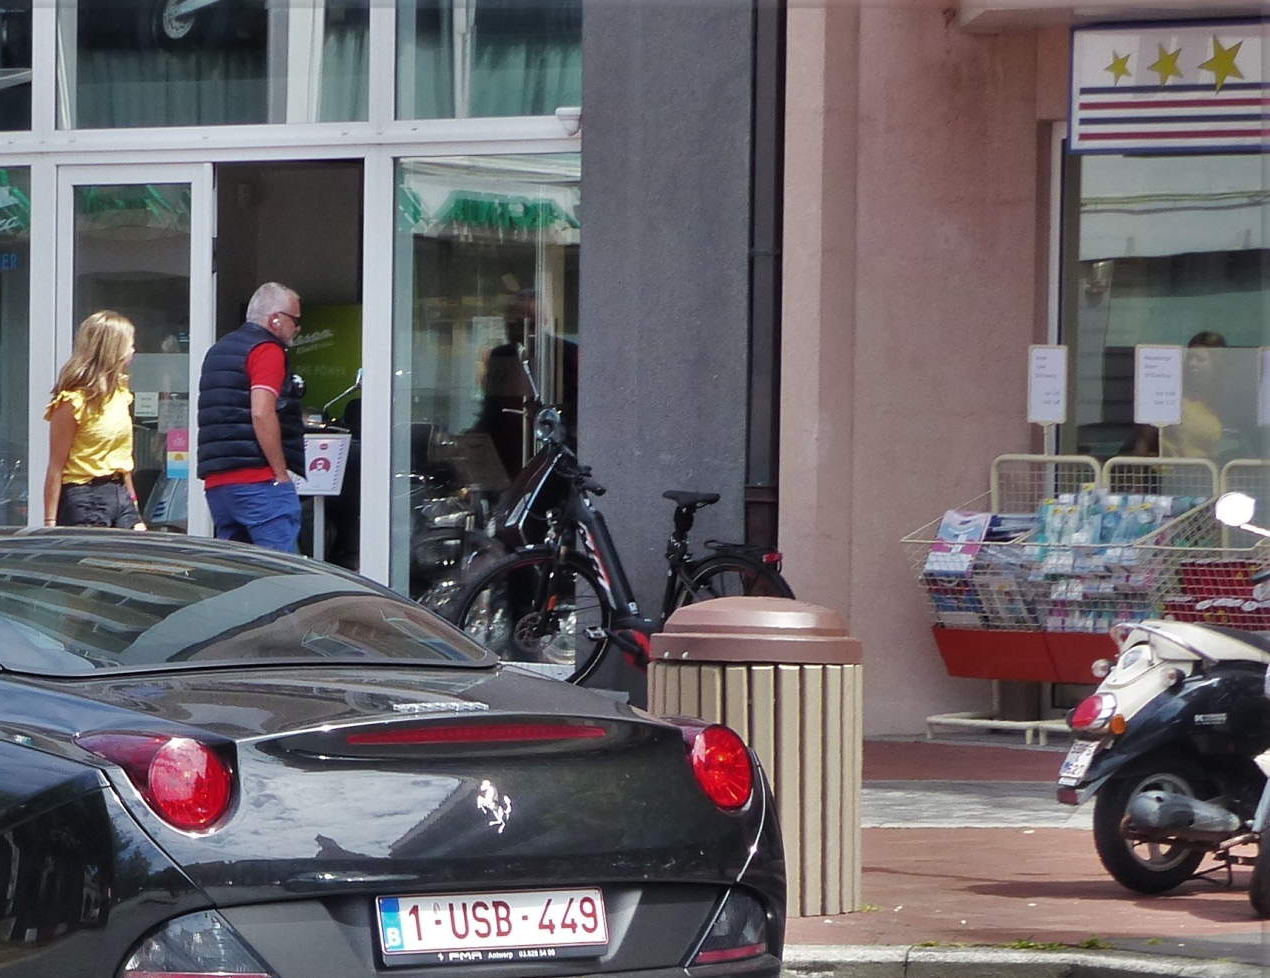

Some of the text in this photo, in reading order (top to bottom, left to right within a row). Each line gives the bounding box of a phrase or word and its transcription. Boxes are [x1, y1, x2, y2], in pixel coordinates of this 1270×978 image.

[387, 896, 599, 947] B 1-USB-449
[487, 951, 514, 960] Antwerp
